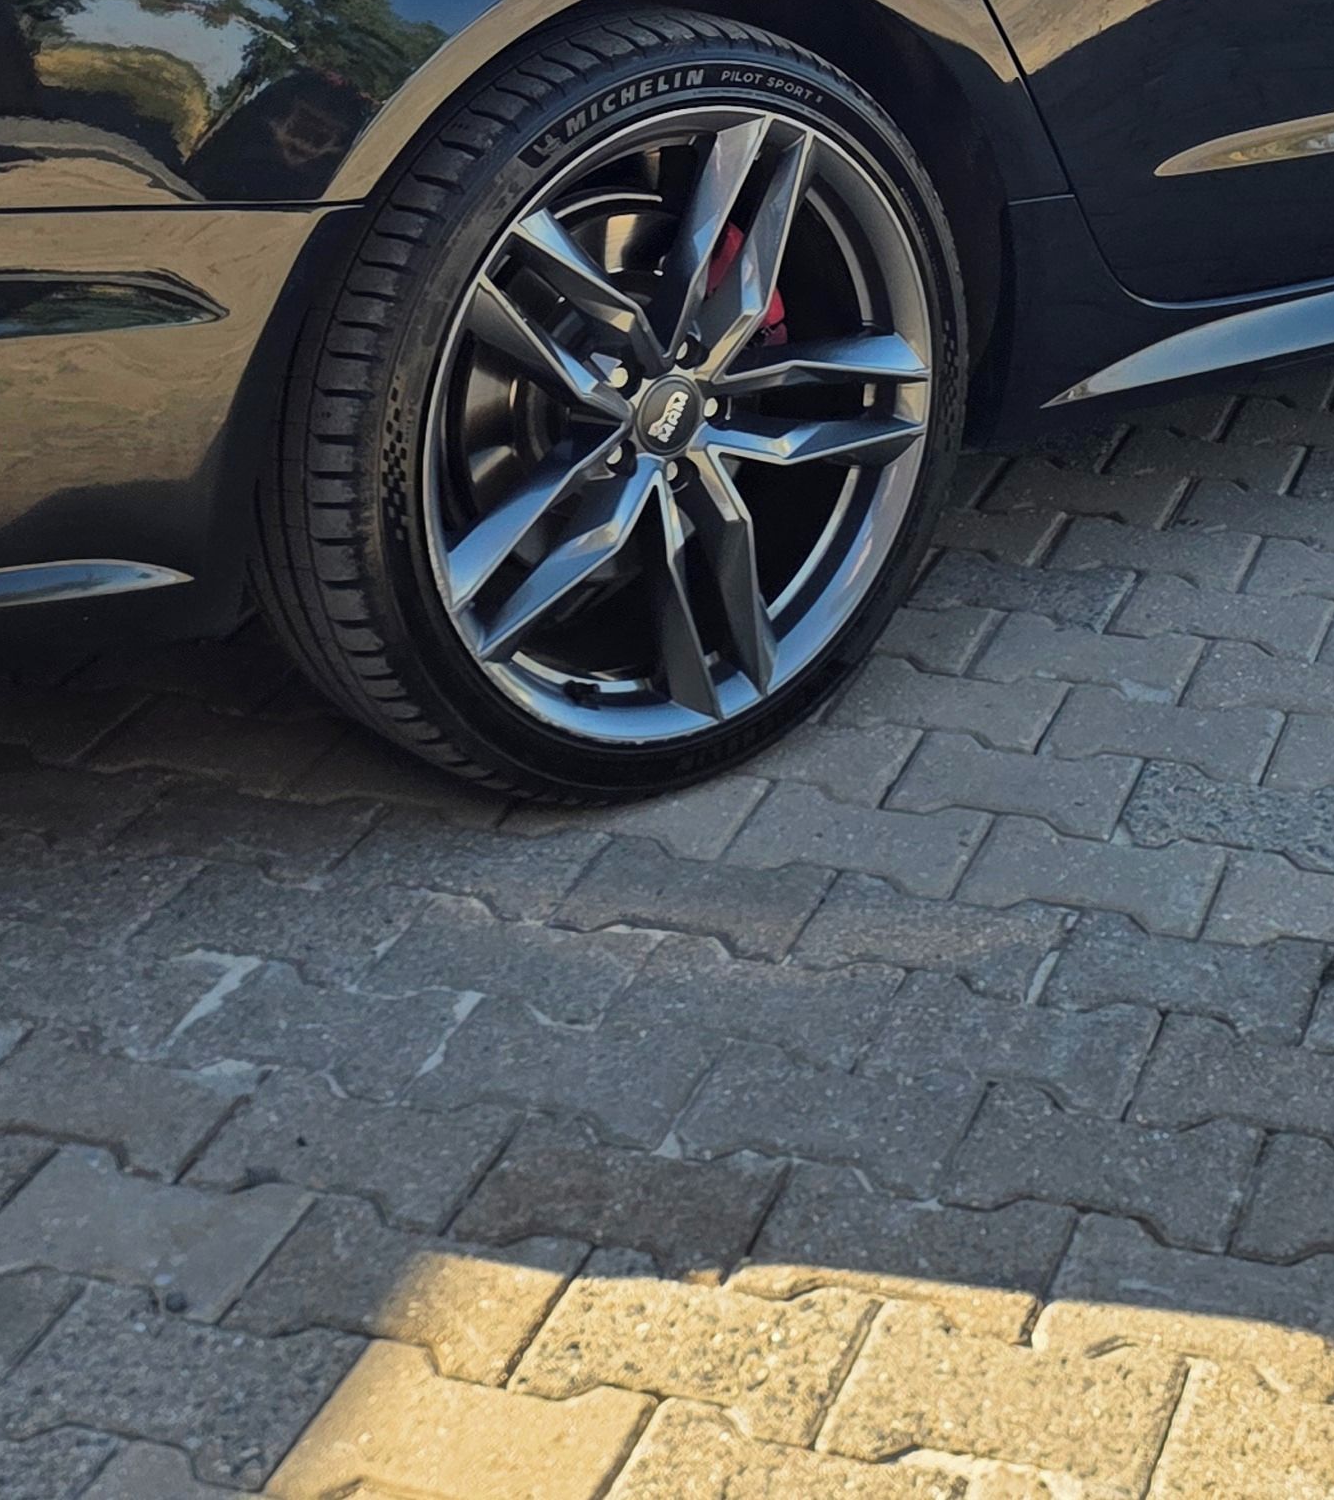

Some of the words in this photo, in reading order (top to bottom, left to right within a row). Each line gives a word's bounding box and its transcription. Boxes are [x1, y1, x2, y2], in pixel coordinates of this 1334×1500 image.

[566, 68, 704, 137] MICHELIN
[720, 70, 763, 85] PILOT
[766, 76, 814, 100] SPORT
